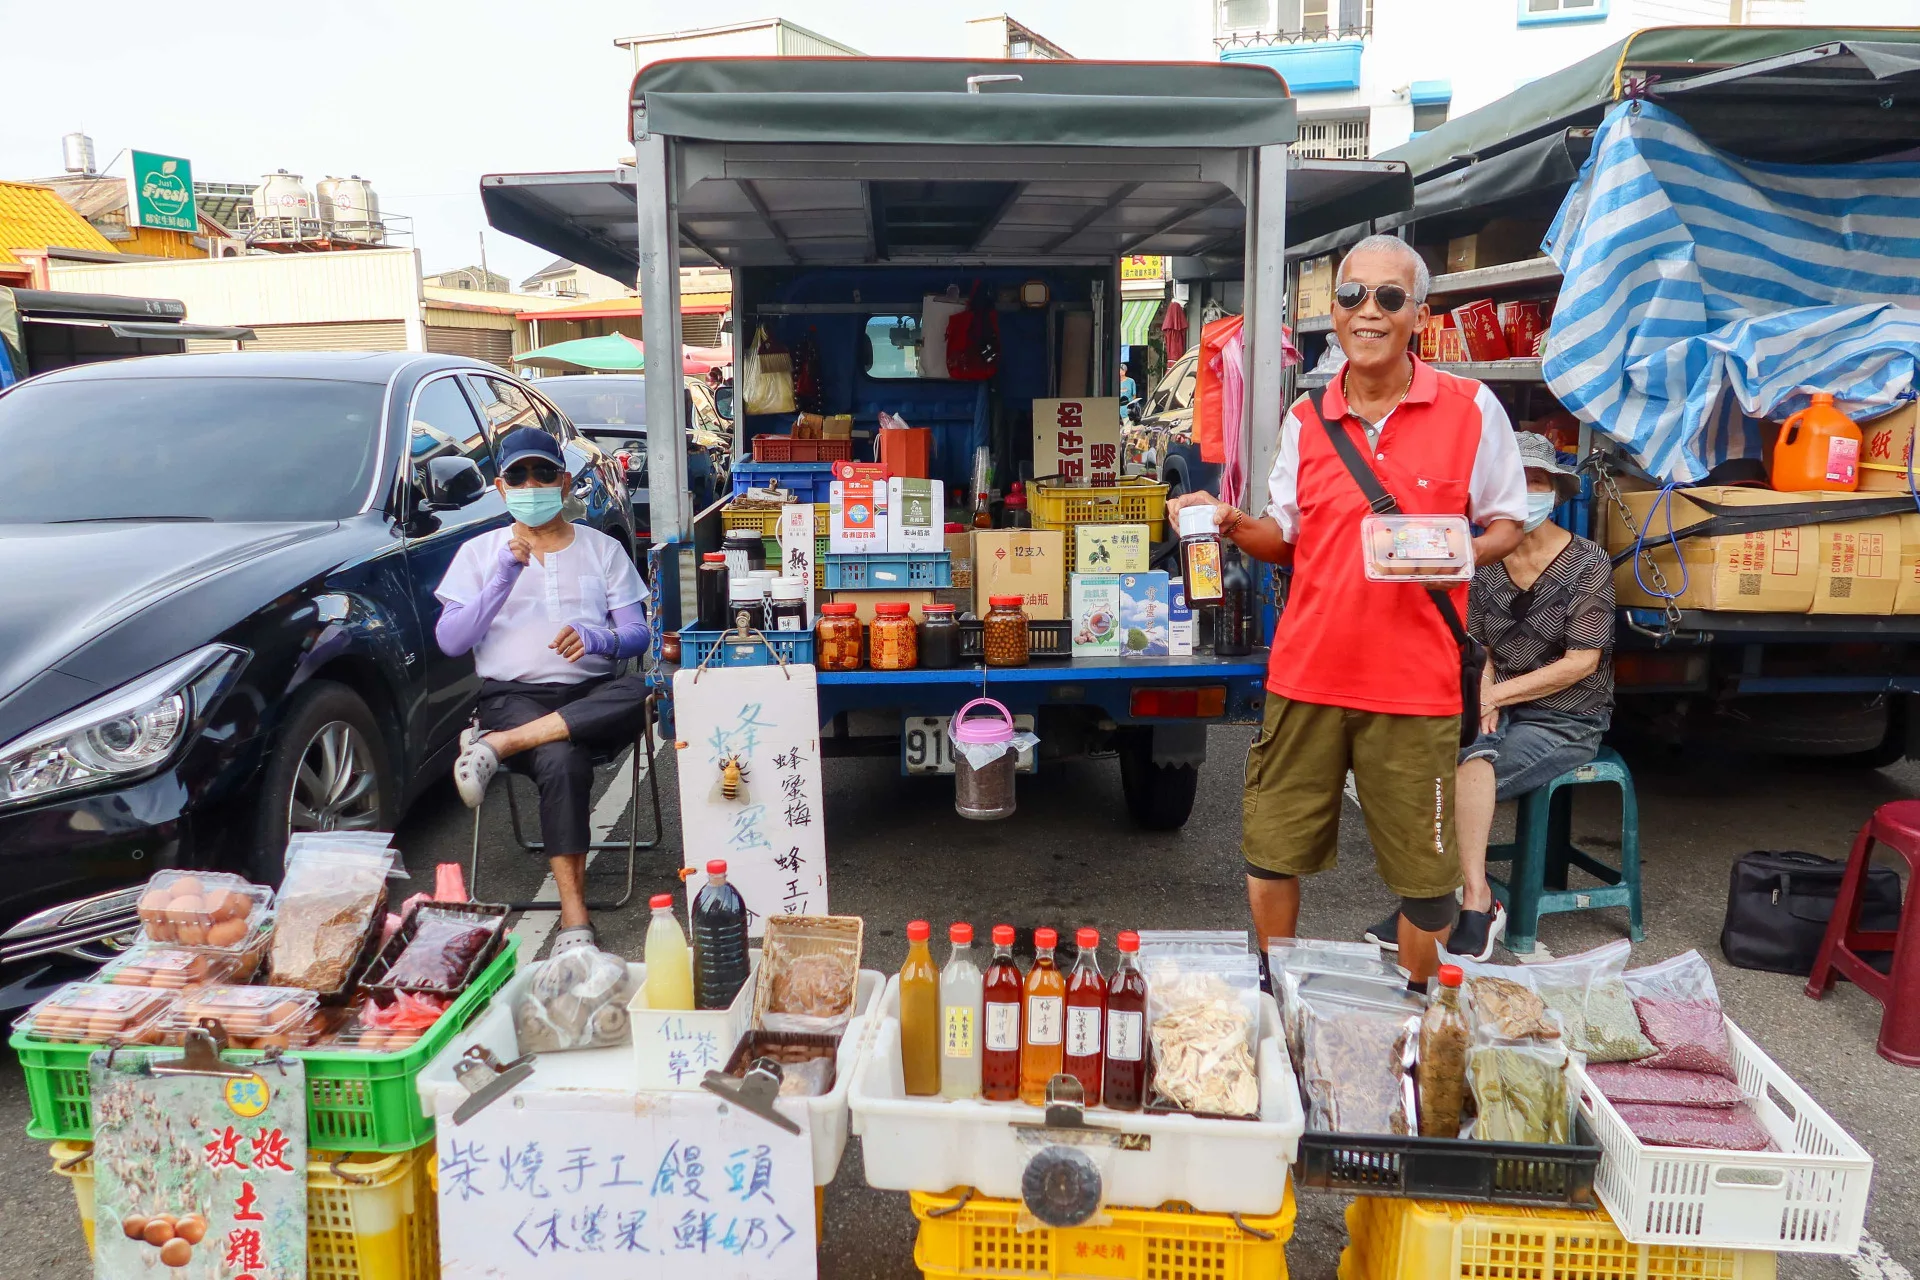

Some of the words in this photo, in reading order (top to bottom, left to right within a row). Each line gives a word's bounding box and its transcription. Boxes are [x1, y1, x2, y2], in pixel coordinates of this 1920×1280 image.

[142, 183, 189, 203] Fresh
[1870, 429, 1893, 460] 紙
[1014, 546, 1046, 558] 12支入
[204, 1125, 295, 1172] 放牧
[225, 1181, 266, 1280] 土雞
